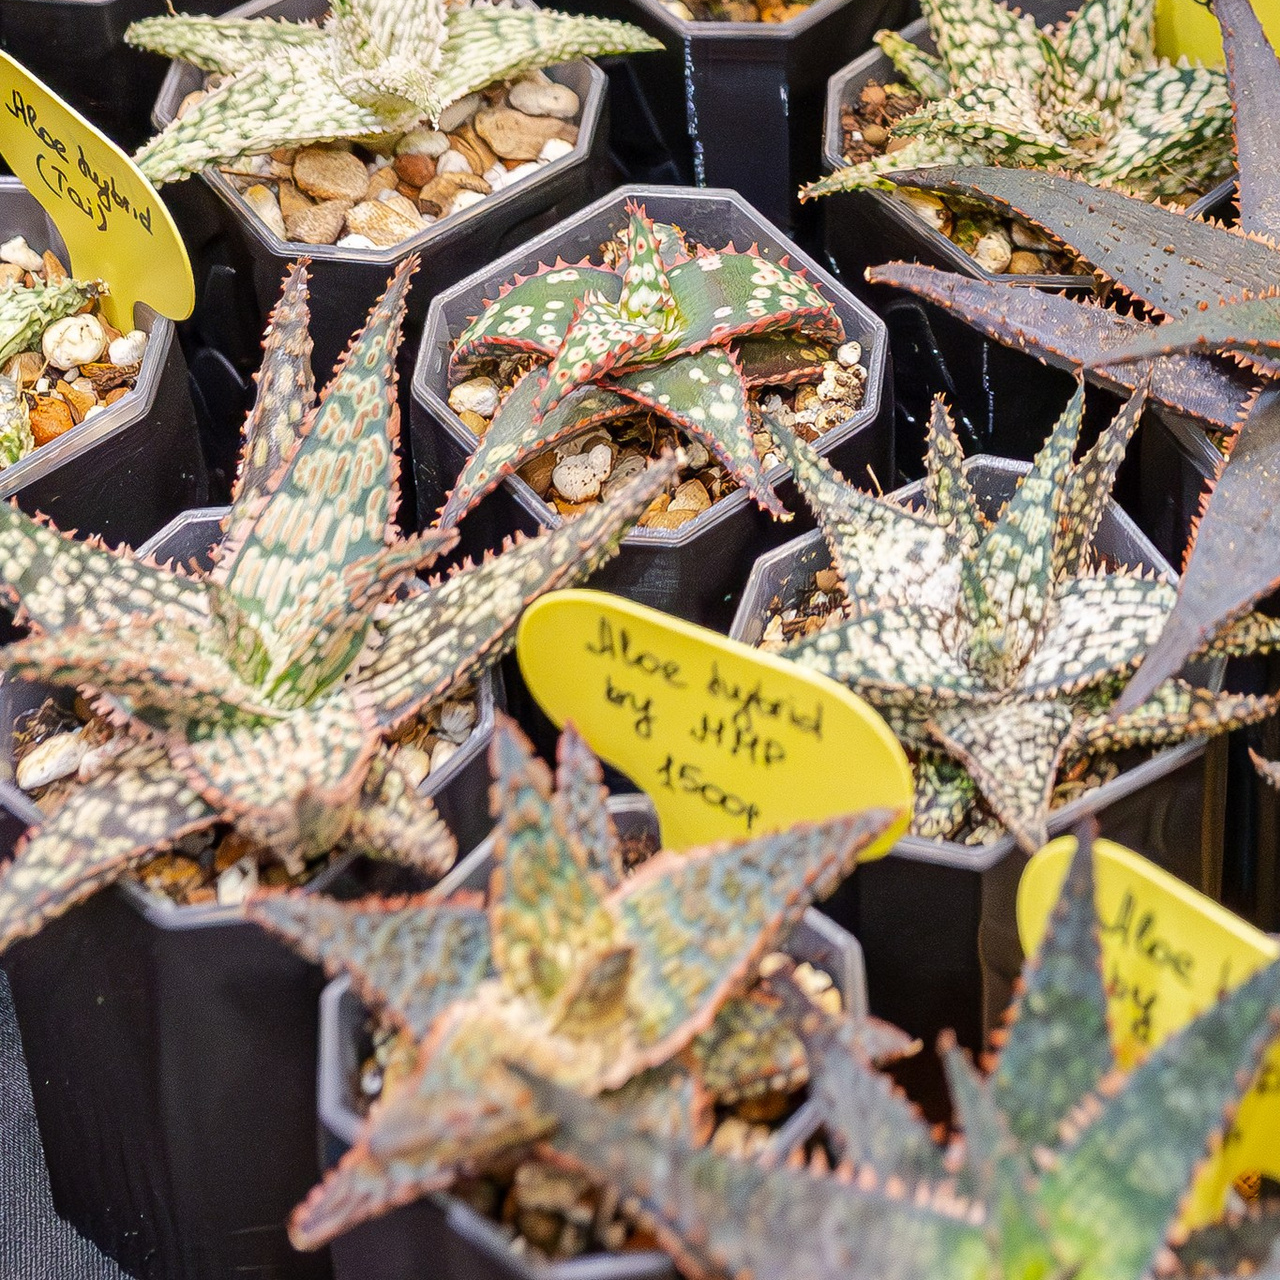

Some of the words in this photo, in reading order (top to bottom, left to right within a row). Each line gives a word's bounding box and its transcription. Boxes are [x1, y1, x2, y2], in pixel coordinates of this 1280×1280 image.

[5, 89, 70, 164] Aloe
[77, 144, 154, 236] hybrid
[585, 615, 688, 690] Aloe
[706, 660, 825, 741] hybrid
[604, 675, 657, 740] by
[656, 752, 762, 831] 1500p
[1100, 887, 1196, 990] Aloe
